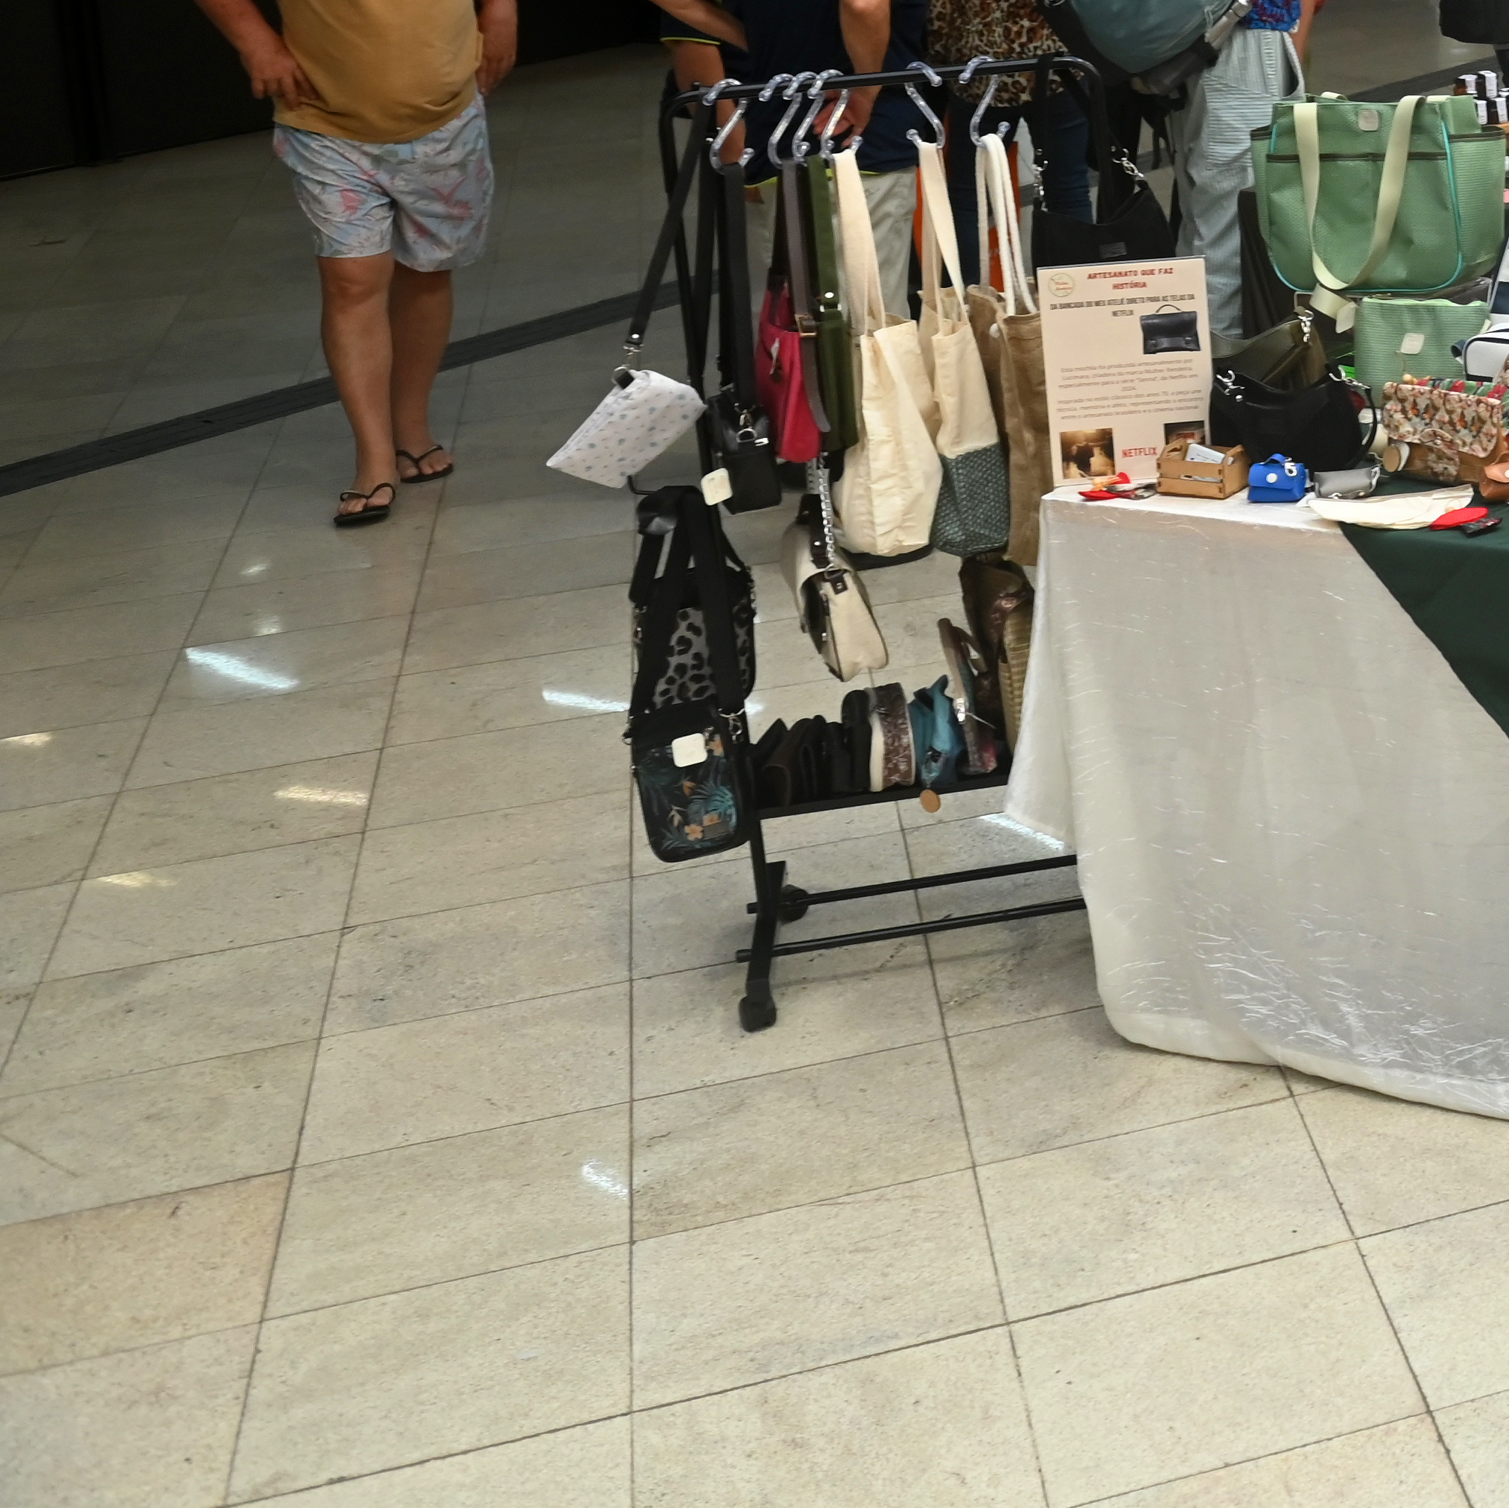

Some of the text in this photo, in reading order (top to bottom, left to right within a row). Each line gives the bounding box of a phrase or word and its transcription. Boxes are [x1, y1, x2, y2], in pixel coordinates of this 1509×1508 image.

[1087, 267, 1174, 279] ARTESANATO QUE FAZ
[1112, 280, 1147, 290] HISTÓRIA
[1121, 446, 1158, 458] NETFLIX
